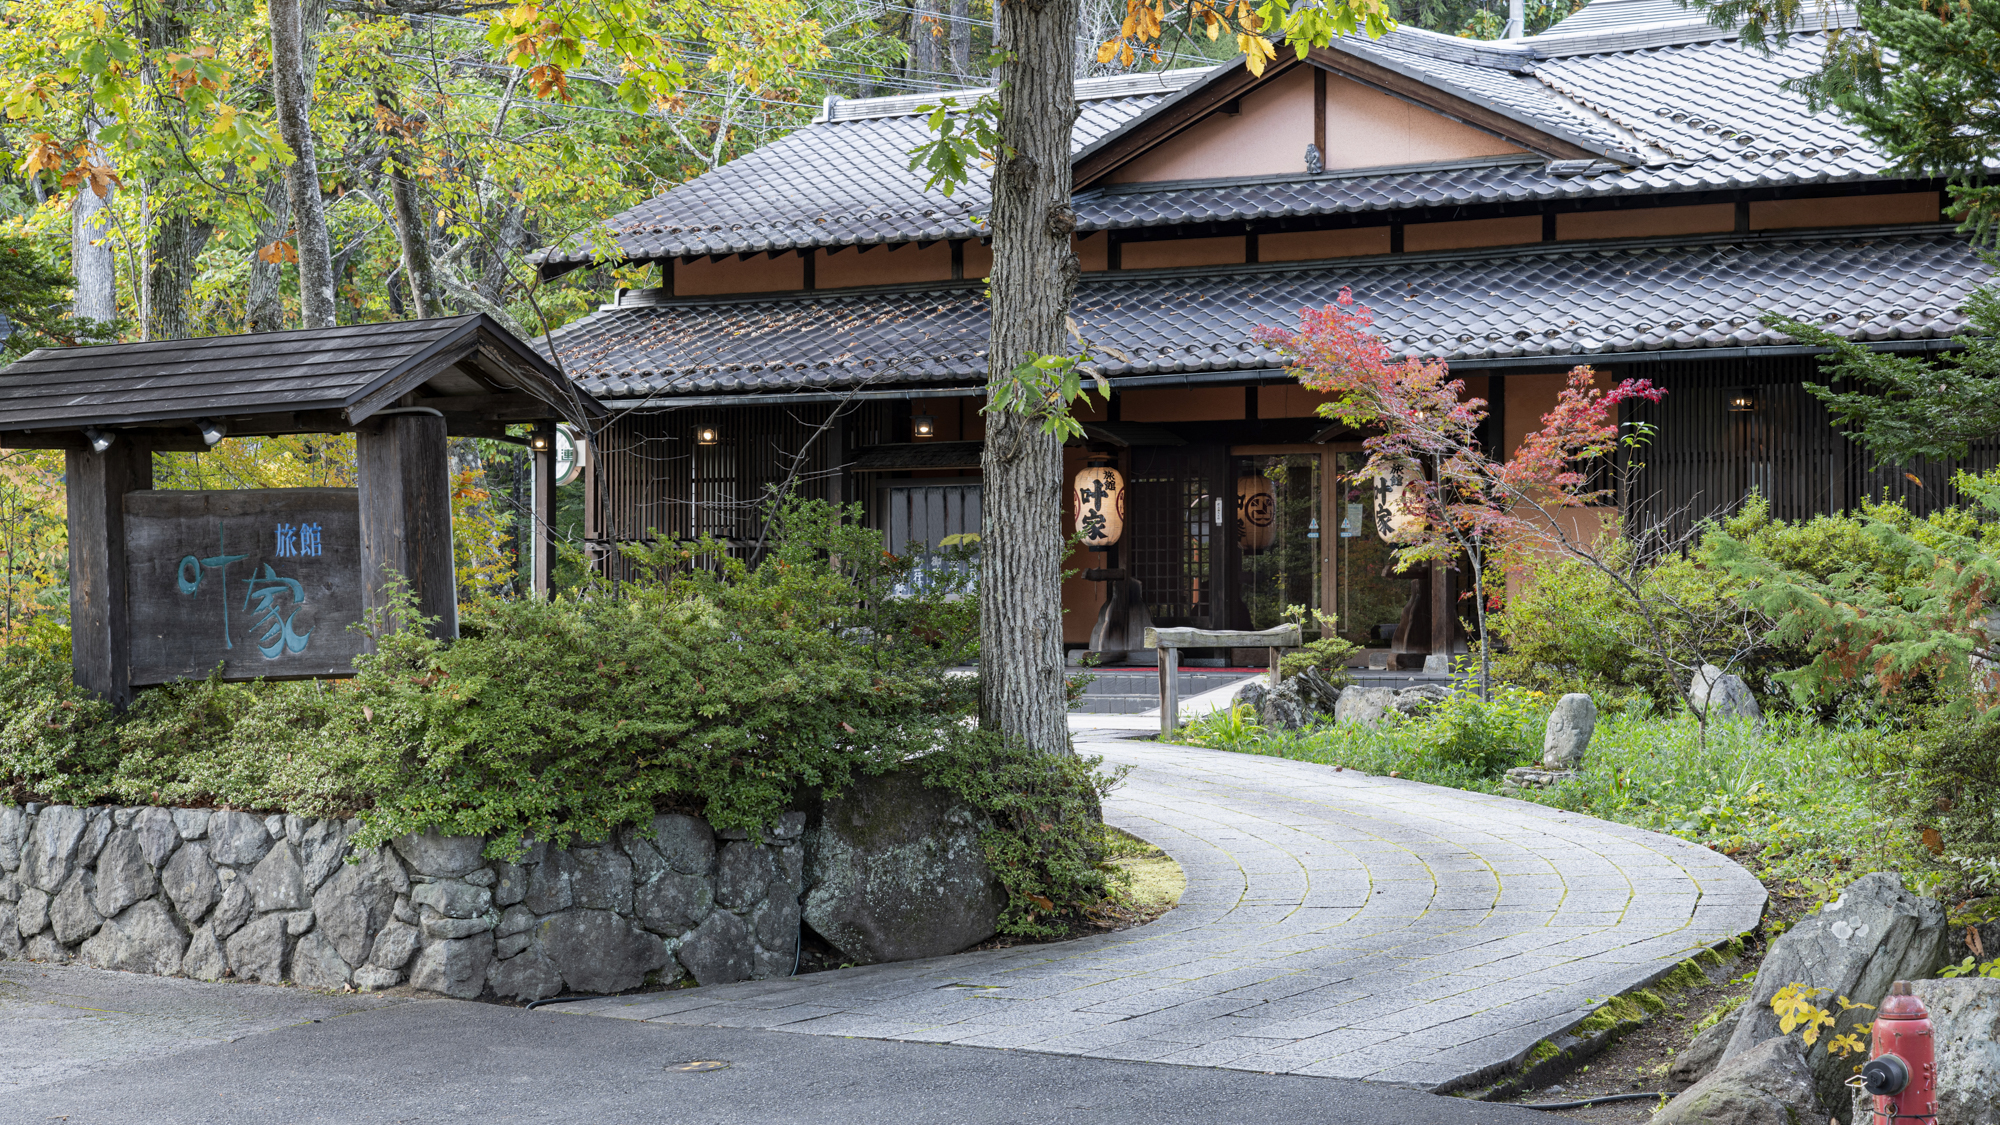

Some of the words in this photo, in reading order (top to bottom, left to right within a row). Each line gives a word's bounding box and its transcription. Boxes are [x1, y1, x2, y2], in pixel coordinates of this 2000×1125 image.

[1103, 470, 1116, 491] 旅館
[1389, 463, 1404, 487] 旅館
[1080, 479, 1108, 541] 叶家
[1374, 476, 1395, 537] 叶家
[274, 521, 323, 558] 旅館
[177, 521, 315, 659] 叶家
